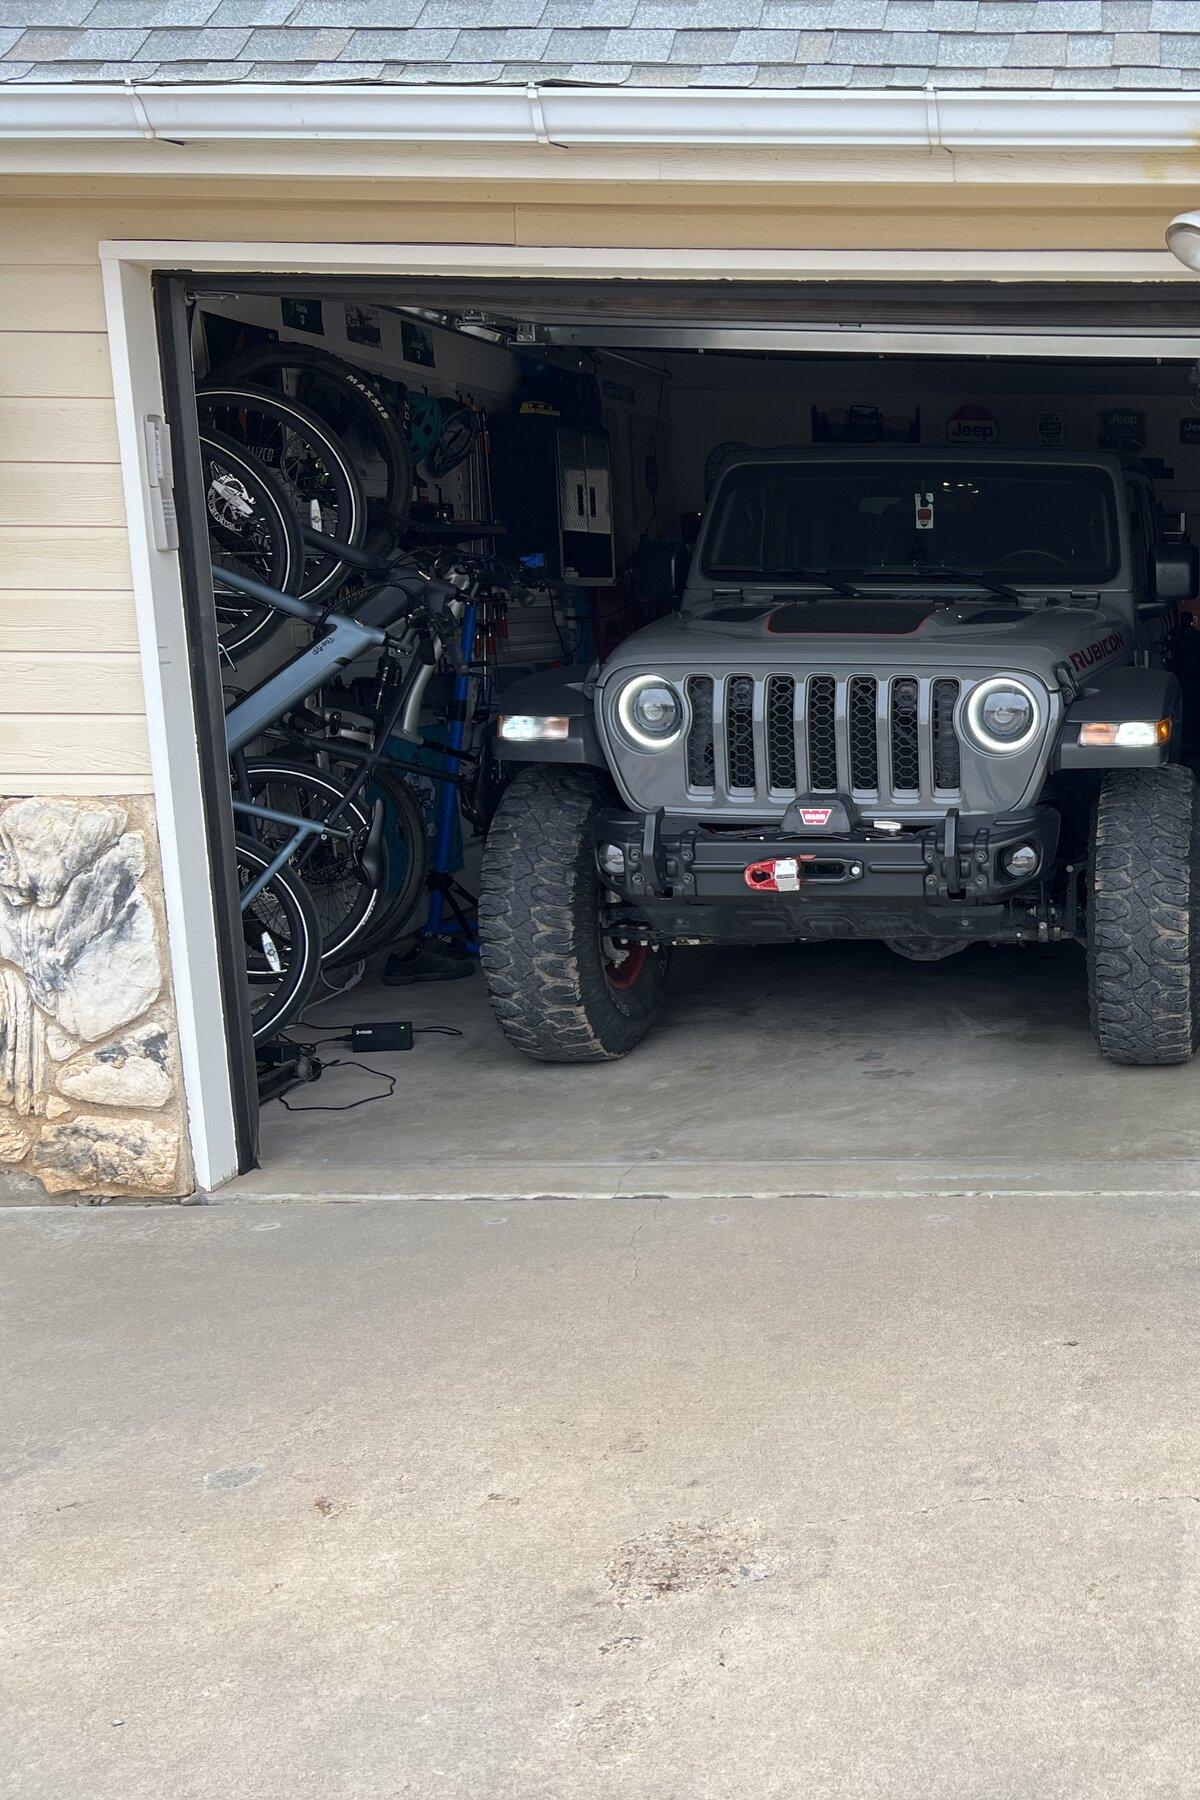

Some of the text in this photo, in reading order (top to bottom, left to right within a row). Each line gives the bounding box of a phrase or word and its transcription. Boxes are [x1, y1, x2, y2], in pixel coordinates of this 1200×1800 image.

[346, 375, 389, 419] MAXXIS
[952, 422, 994, 440] Jeep
[1107, 414, 1137, 426] Jeep
[1069, 631, 1127, 672] RUBICON
